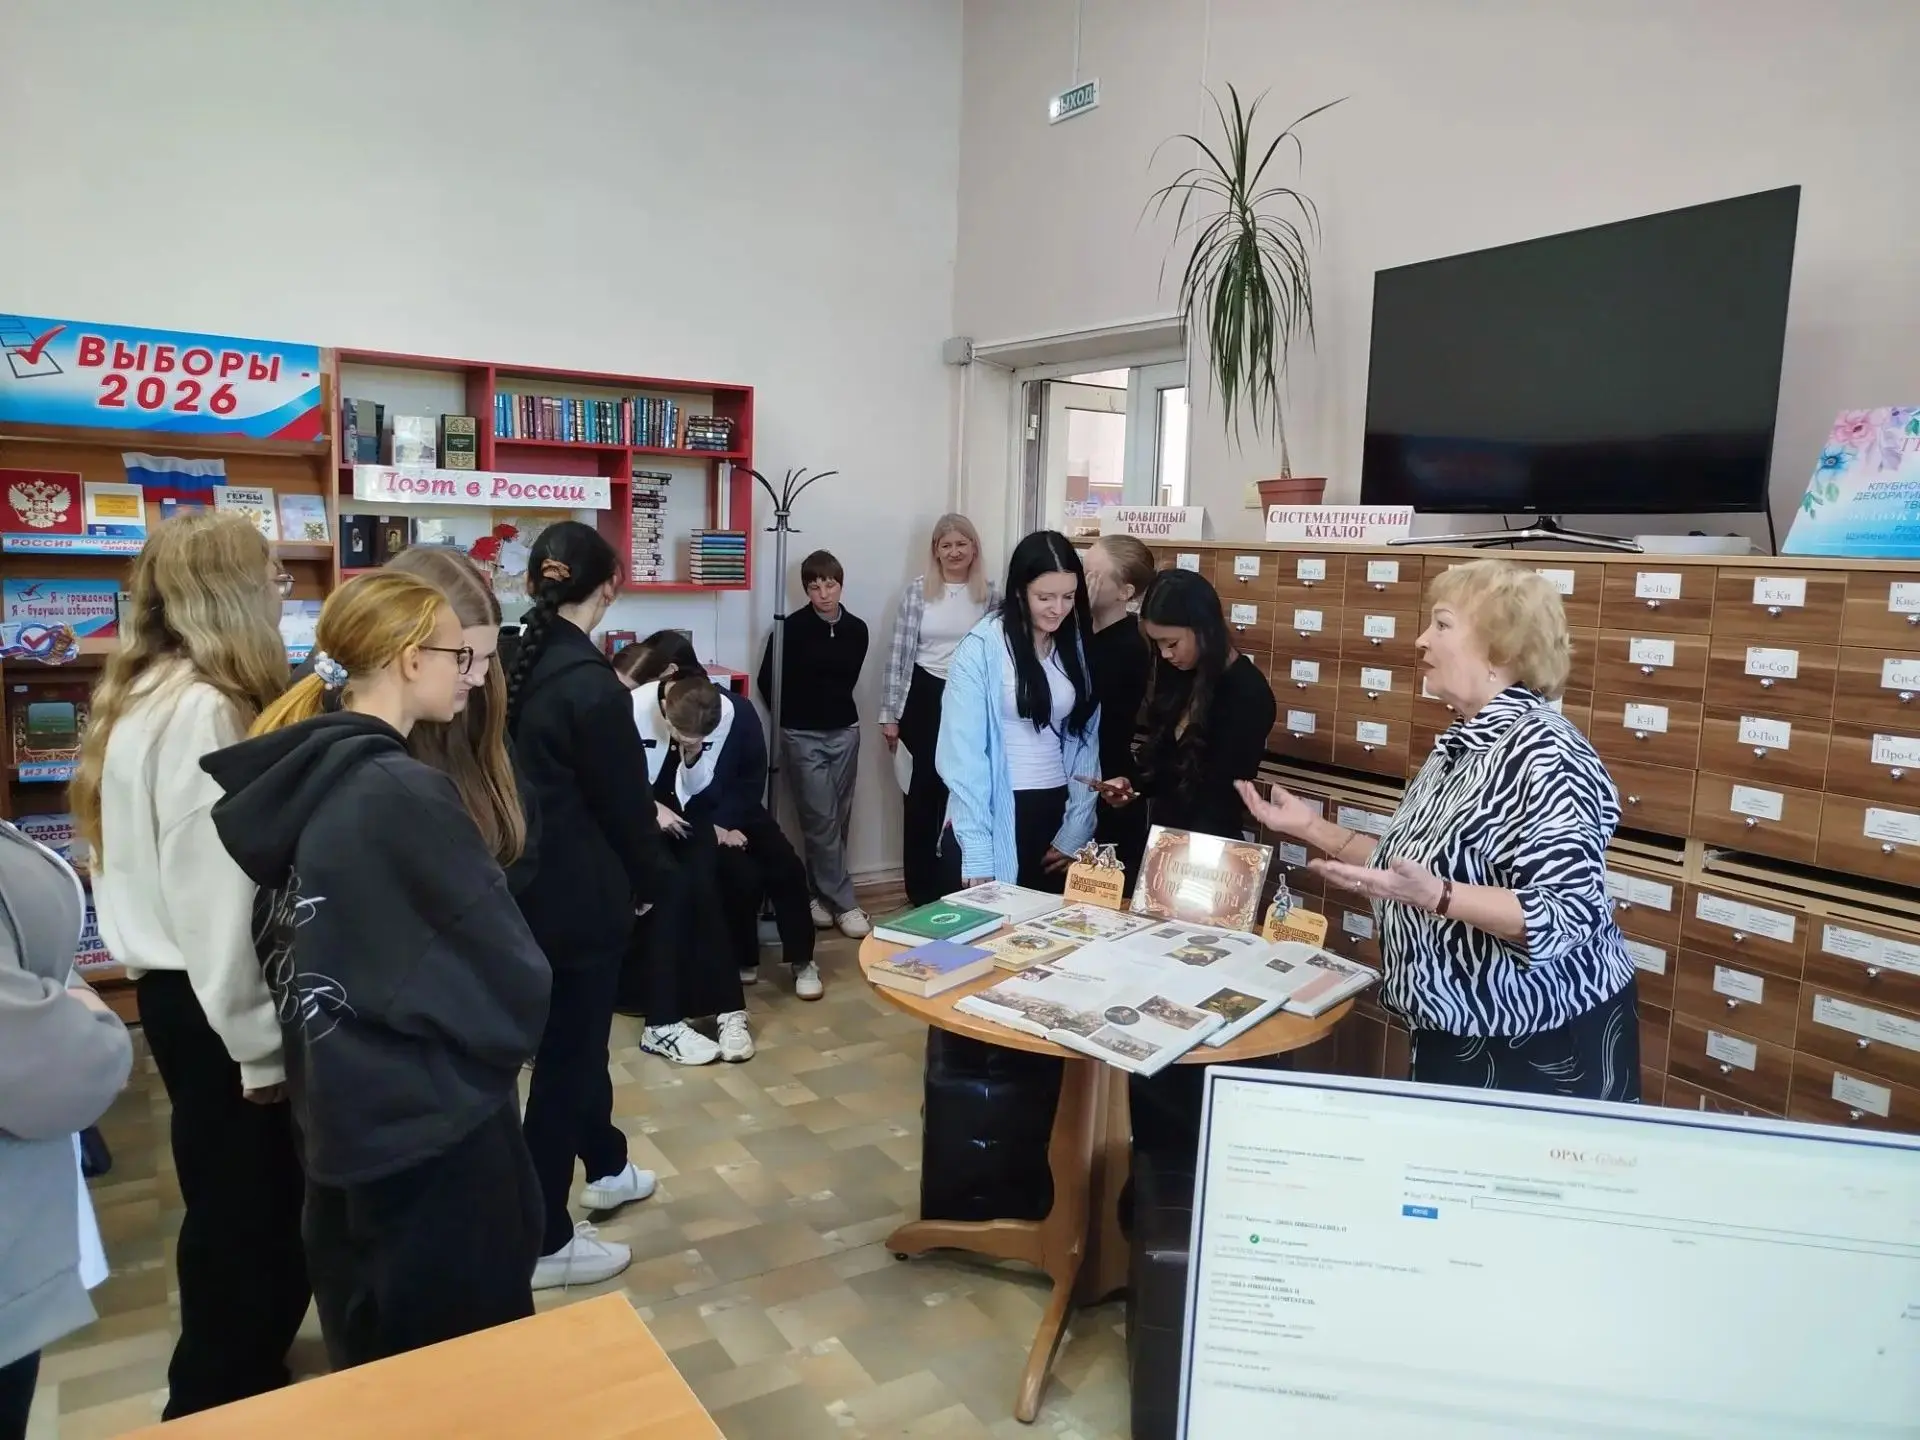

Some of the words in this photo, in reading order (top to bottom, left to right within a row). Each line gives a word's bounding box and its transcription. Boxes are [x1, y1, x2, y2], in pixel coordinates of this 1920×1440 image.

[78, 335, 281, 382] ВЫБОРЫ
[98, 374, 237, 414] 2026
[465, 481, 483, 497] в
[489, 477, 586, 501] России
[1116, 509, 1187, 523] АЛФАВИТНЫЙ
[1269, 510, 1409, 525] СИСТЕМАТИЧЕСКИЙ
[1127, 523, 1173, 534] КАТАЛОГ
[1304, 525, 1367, 538] КАТАЛОГ
[11, 539, 73, 547] РОССИЯ
